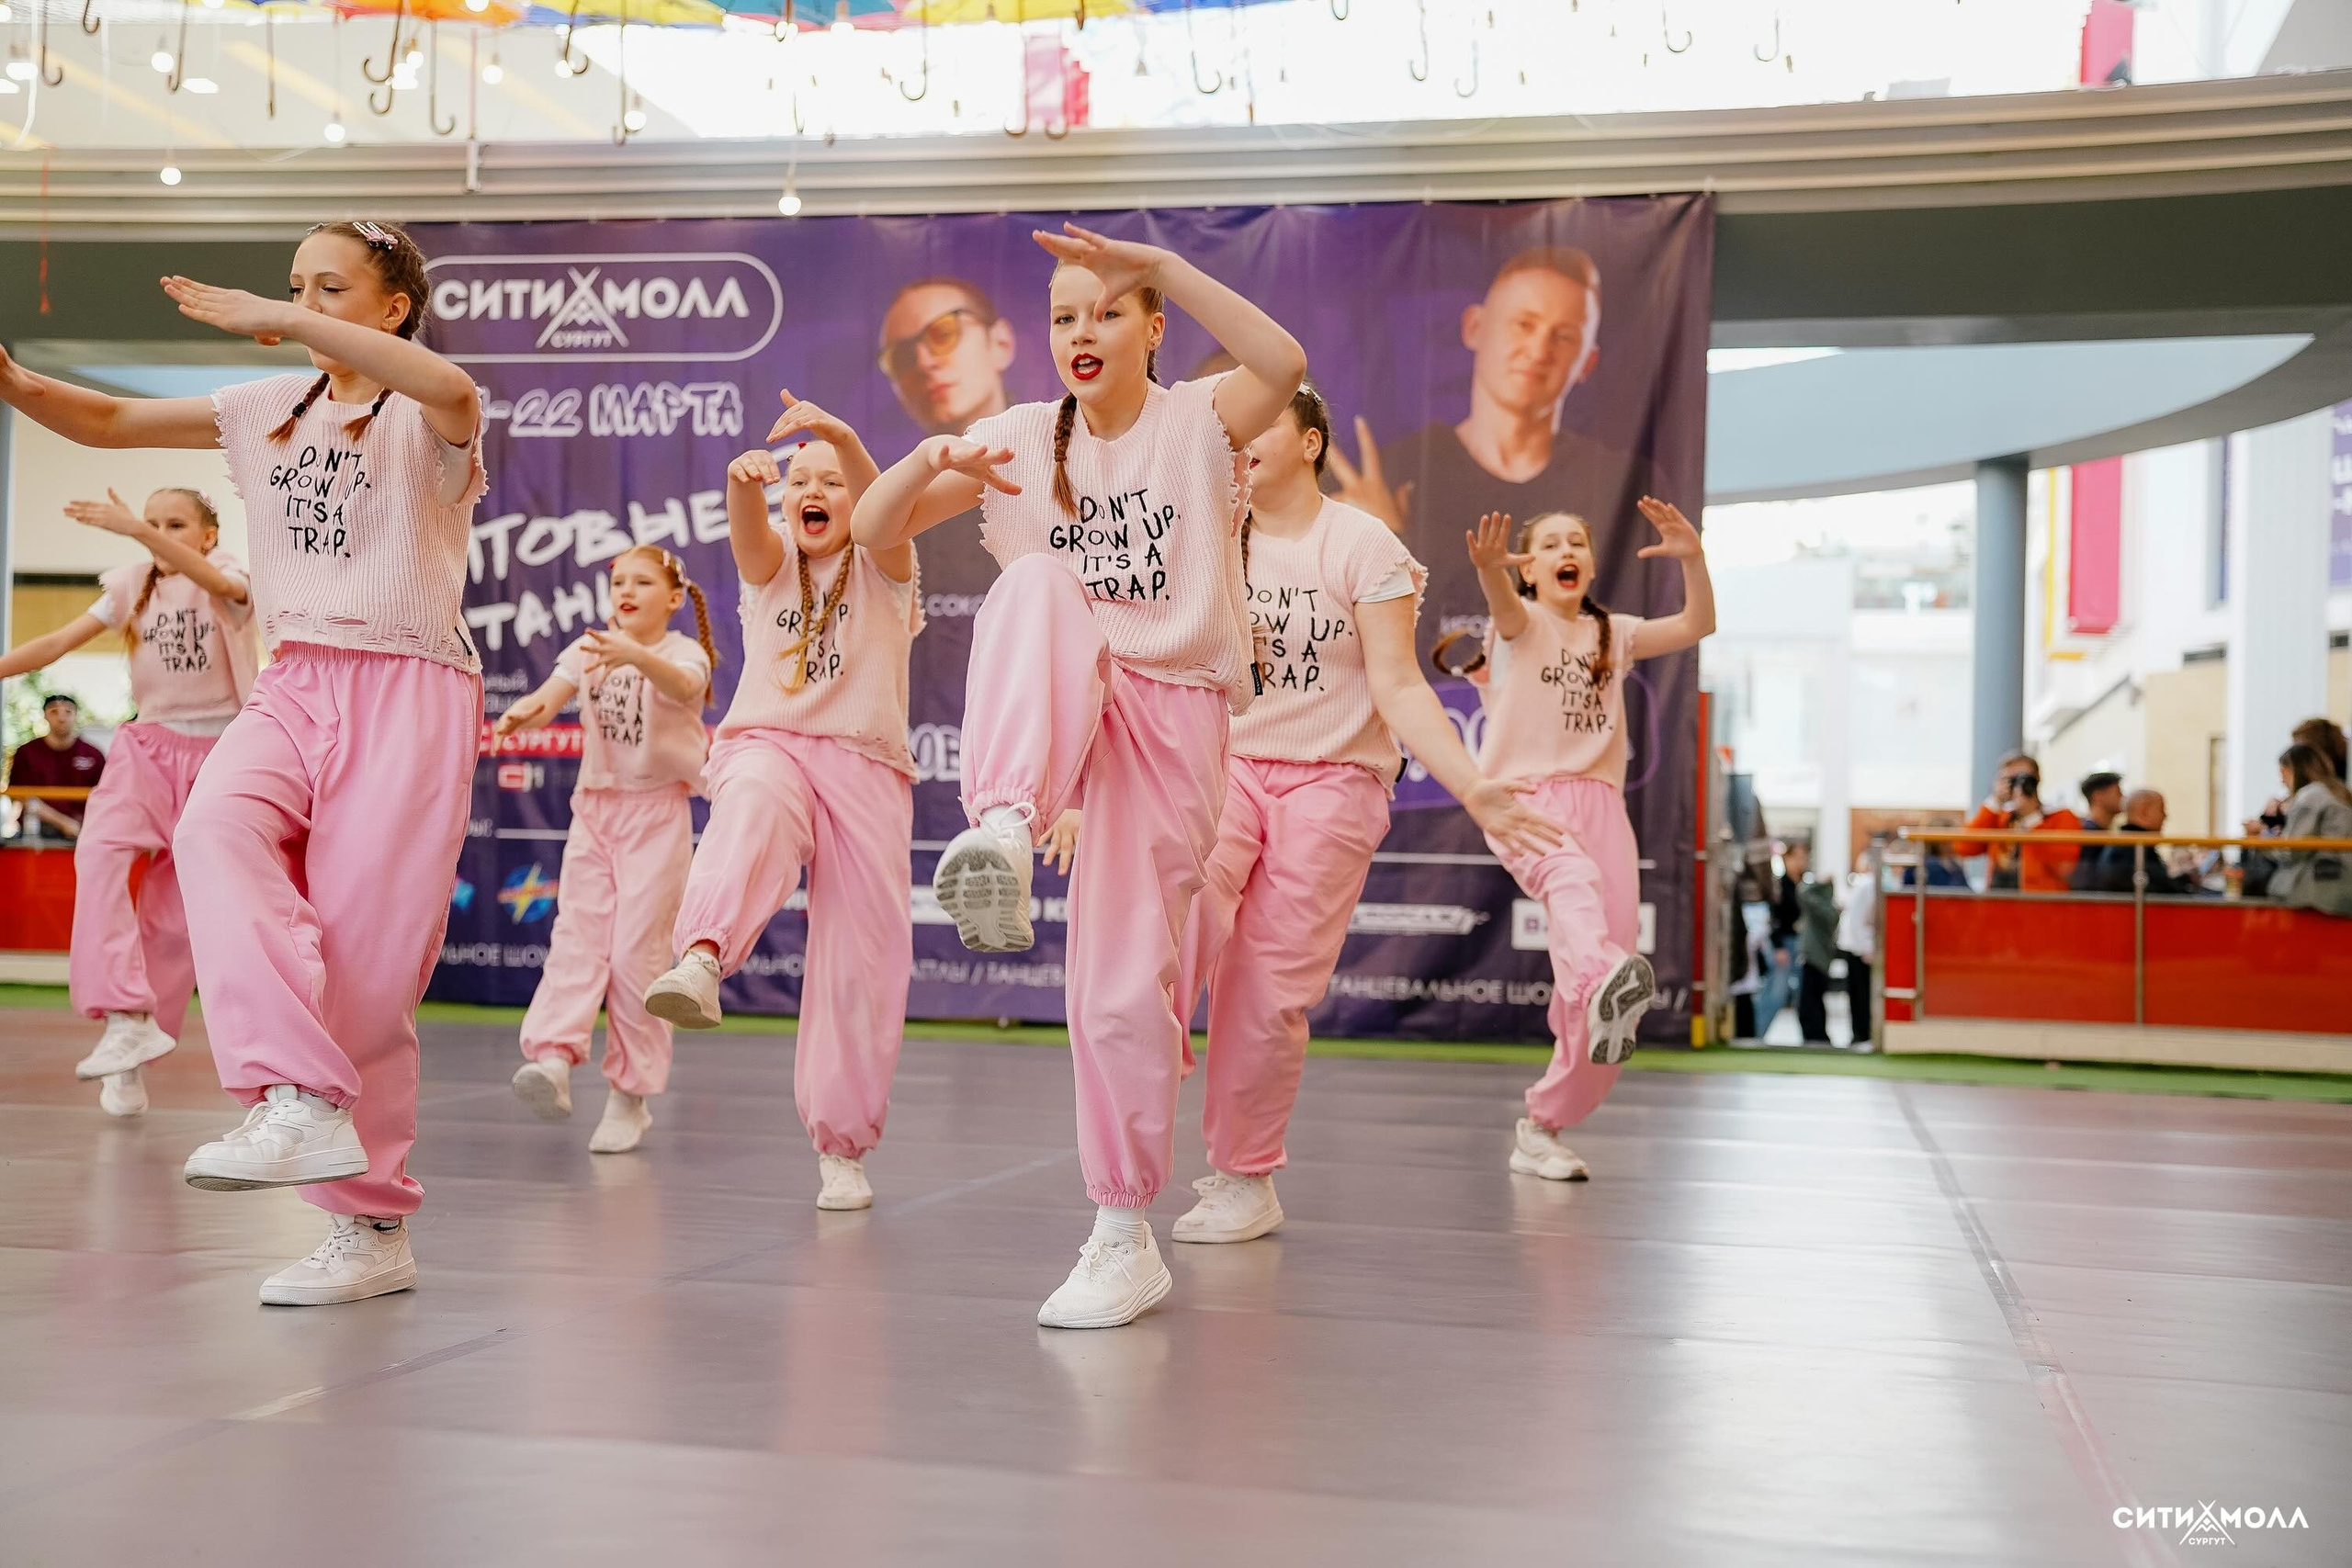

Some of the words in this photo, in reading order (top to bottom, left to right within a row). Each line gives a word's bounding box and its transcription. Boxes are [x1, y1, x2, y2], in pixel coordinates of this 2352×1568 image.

[589, 381, 743, 437] МАРТА
[300, 446, 363, 473] DON'T
[270, 465, 335, 498] GROW
[287, 494, 328, 523] IT'S
[333, 502, 344, 525] A
[1080, 489, 1148, 524] DON'T
[288, 526, 351, 558] TRAP.
[1050, 524, 1128, 553] GROW
[1143, 505, 1181, 540] UP.
[1083, 554, 1131, 574] IT'S
[1145, 542, 1163, 567] A
[1085, 570, 1170, 601] TRAP.
[1311, 617, 1352, 641] UP.
[1301, 640, 1317, 662] A
[796, 653, 843, 683] RAP.
[1262, 662, 1324, 692] RAP.
[1563, 690, 1591, 709] IT'S
[1594, 693, 1603, 712] A
[1563, 713, 1613, 734] TRAP.
